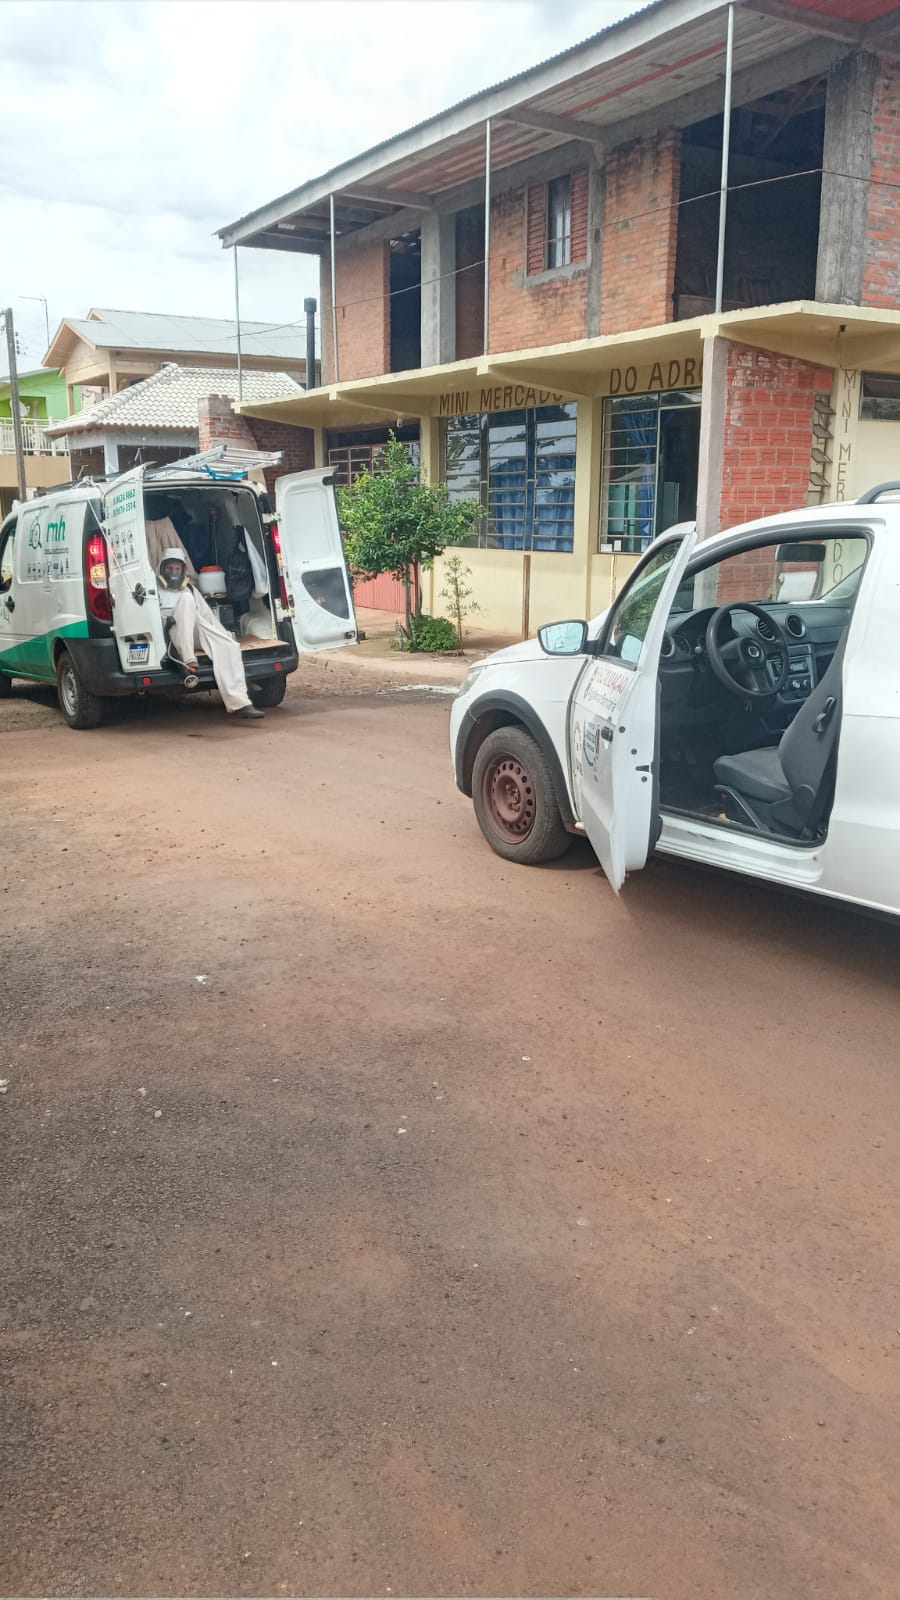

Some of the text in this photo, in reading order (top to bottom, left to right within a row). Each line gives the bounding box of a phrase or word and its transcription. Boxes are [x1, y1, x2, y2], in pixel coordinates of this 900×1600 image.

[440, 391, 469, 415] MINI
[609, 366, 638, 394] DO
[841, 369, 857, 433] MINI
